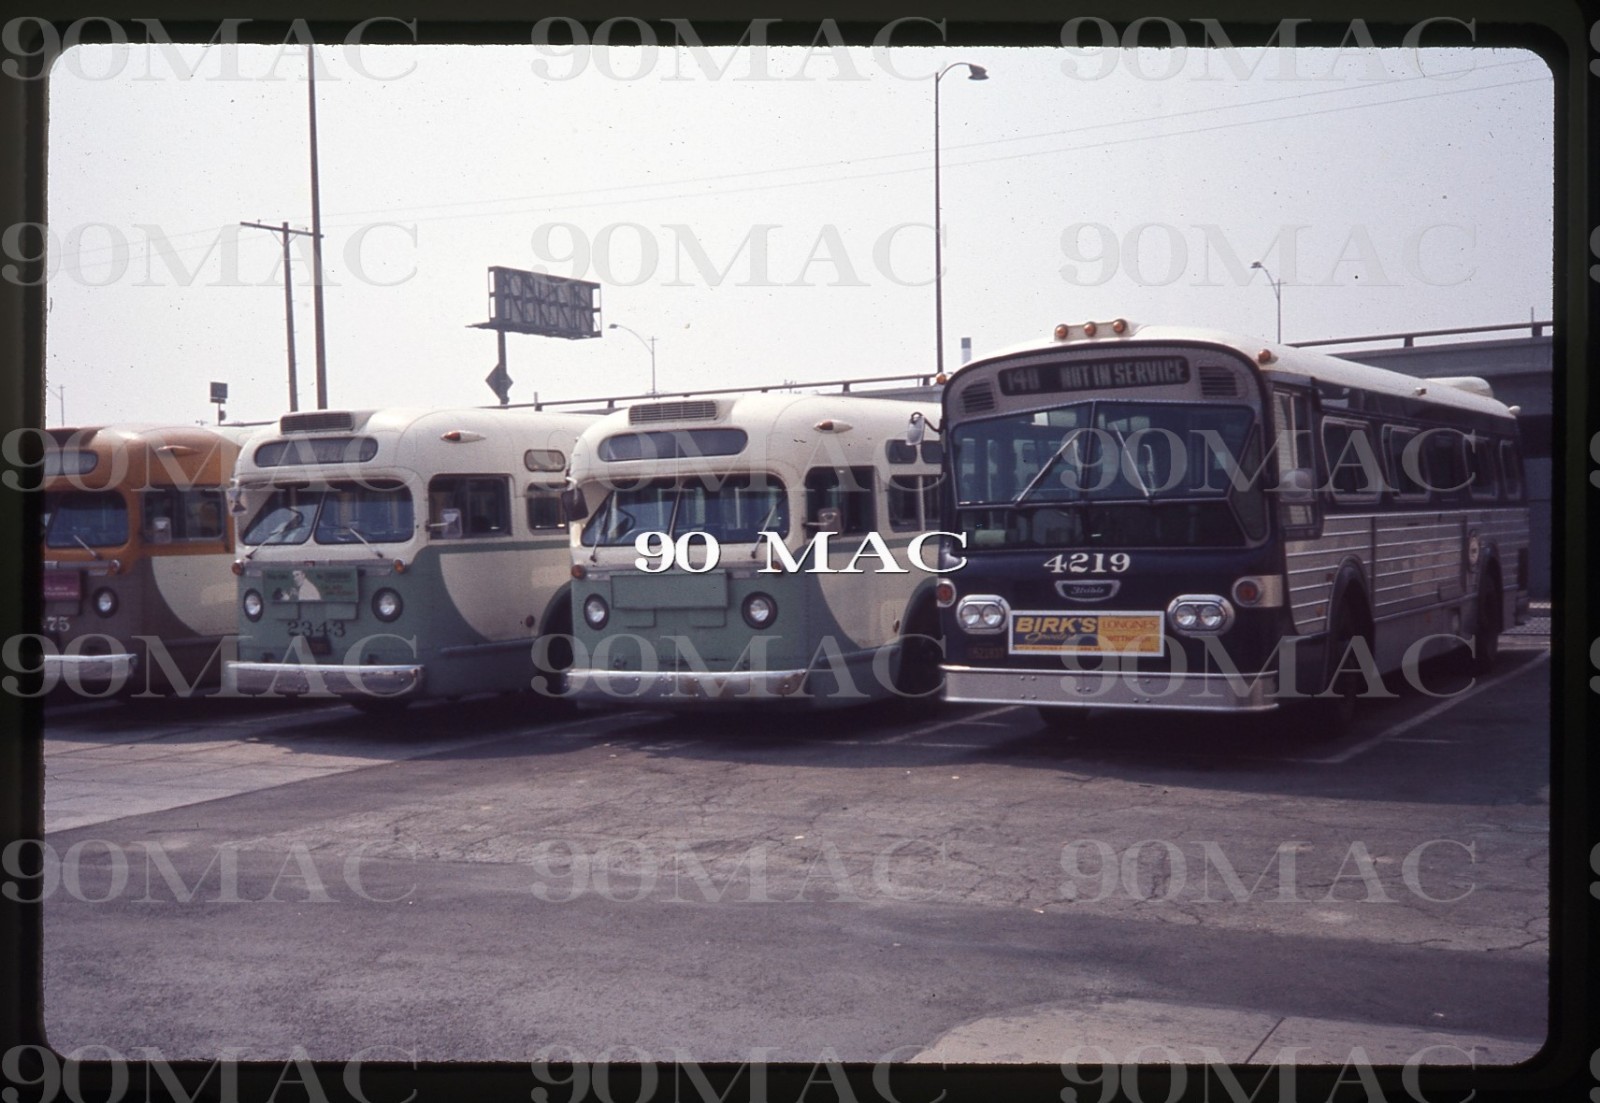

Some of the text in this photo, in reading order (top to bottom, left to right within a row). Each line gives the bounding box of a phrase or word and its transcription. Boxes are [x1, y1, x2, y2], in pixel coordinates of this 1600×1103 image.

[1059, 365, 1093, 389] NOT
[1094, 363, 1112, 386] IN
[1113, 359, 1185, 384] SERVICE
[1043, 553, 1131, 574] 4219
[44, 616, 70, 632] 75
[287, 620, 346, 637] 2343
[1015, 617, 1097, 633] BIRK'S
